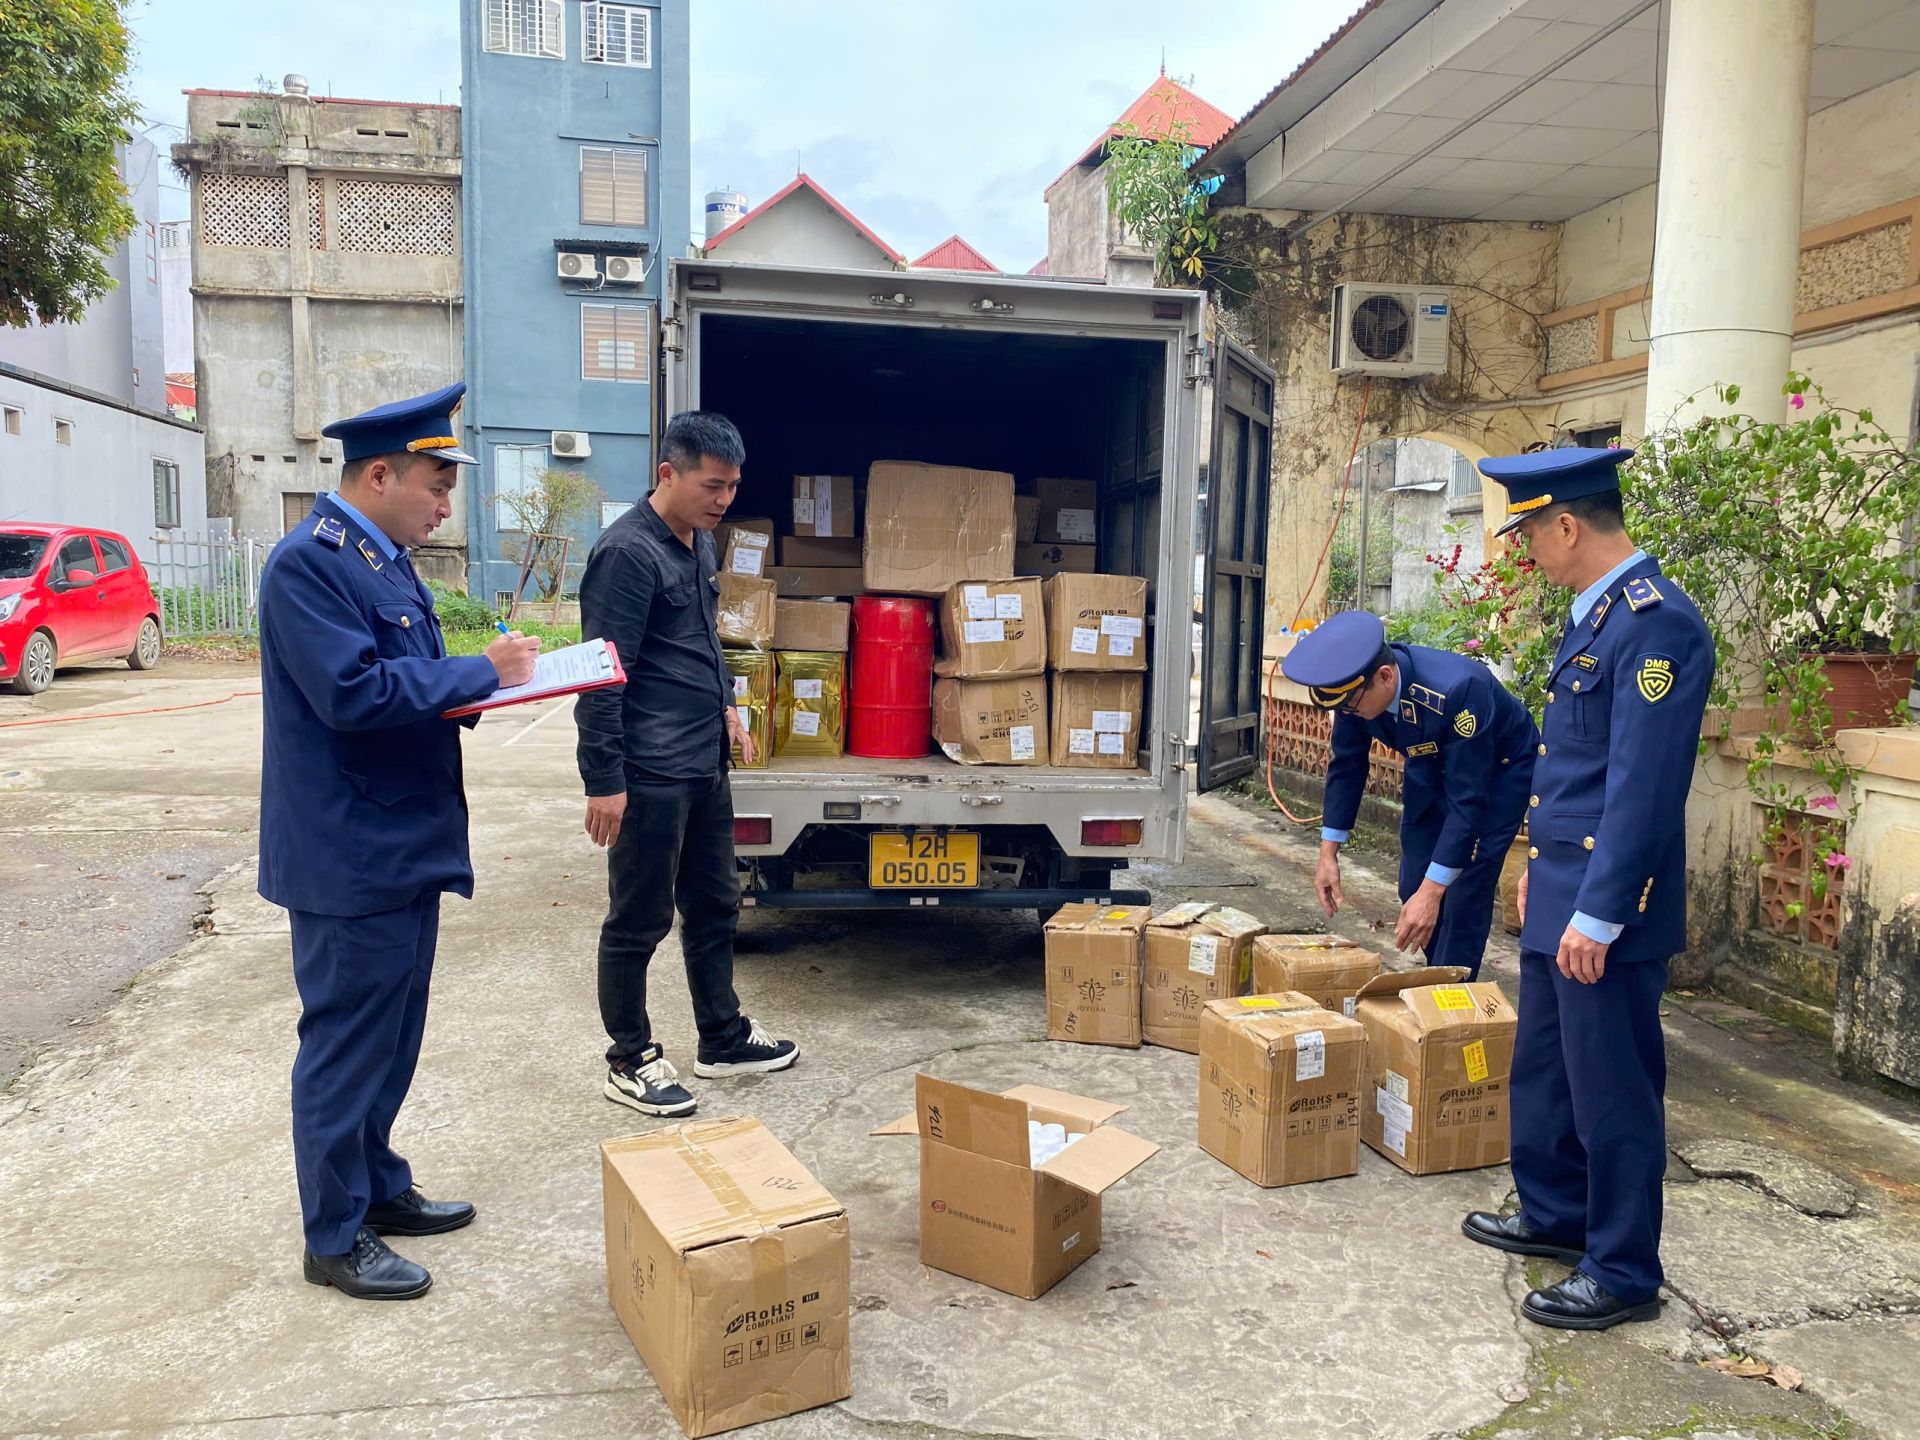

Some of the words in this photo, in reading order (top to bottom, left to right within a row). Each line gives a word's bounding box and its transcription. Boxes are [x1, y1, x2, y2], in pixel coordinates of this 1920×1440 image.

[1644, 658, 1671, 670] DMS
[1454, 708, 1470, 722] DMS
[905, 836, 948, 858] 12H
[882, 862, 966, 884] 050.05
[1076, 1005, 1106, 1014] JOYUAN
[1168, 1010, 1198, 1022] JOYUAN
[1451, 1086, 1484, 1098] RoHS
[1301, 1094, 1333, 1107] RoHS
[1451, 1095, 1482, 1104] COMPLIANT
[1300, 1103, 1332, 1113] COMPLIANT
[761, 1175, 804, 1191] 1326
[745, 1299, 795, 1324] RoHS
[745, 1312, 796, 1332] COMPLIANT
